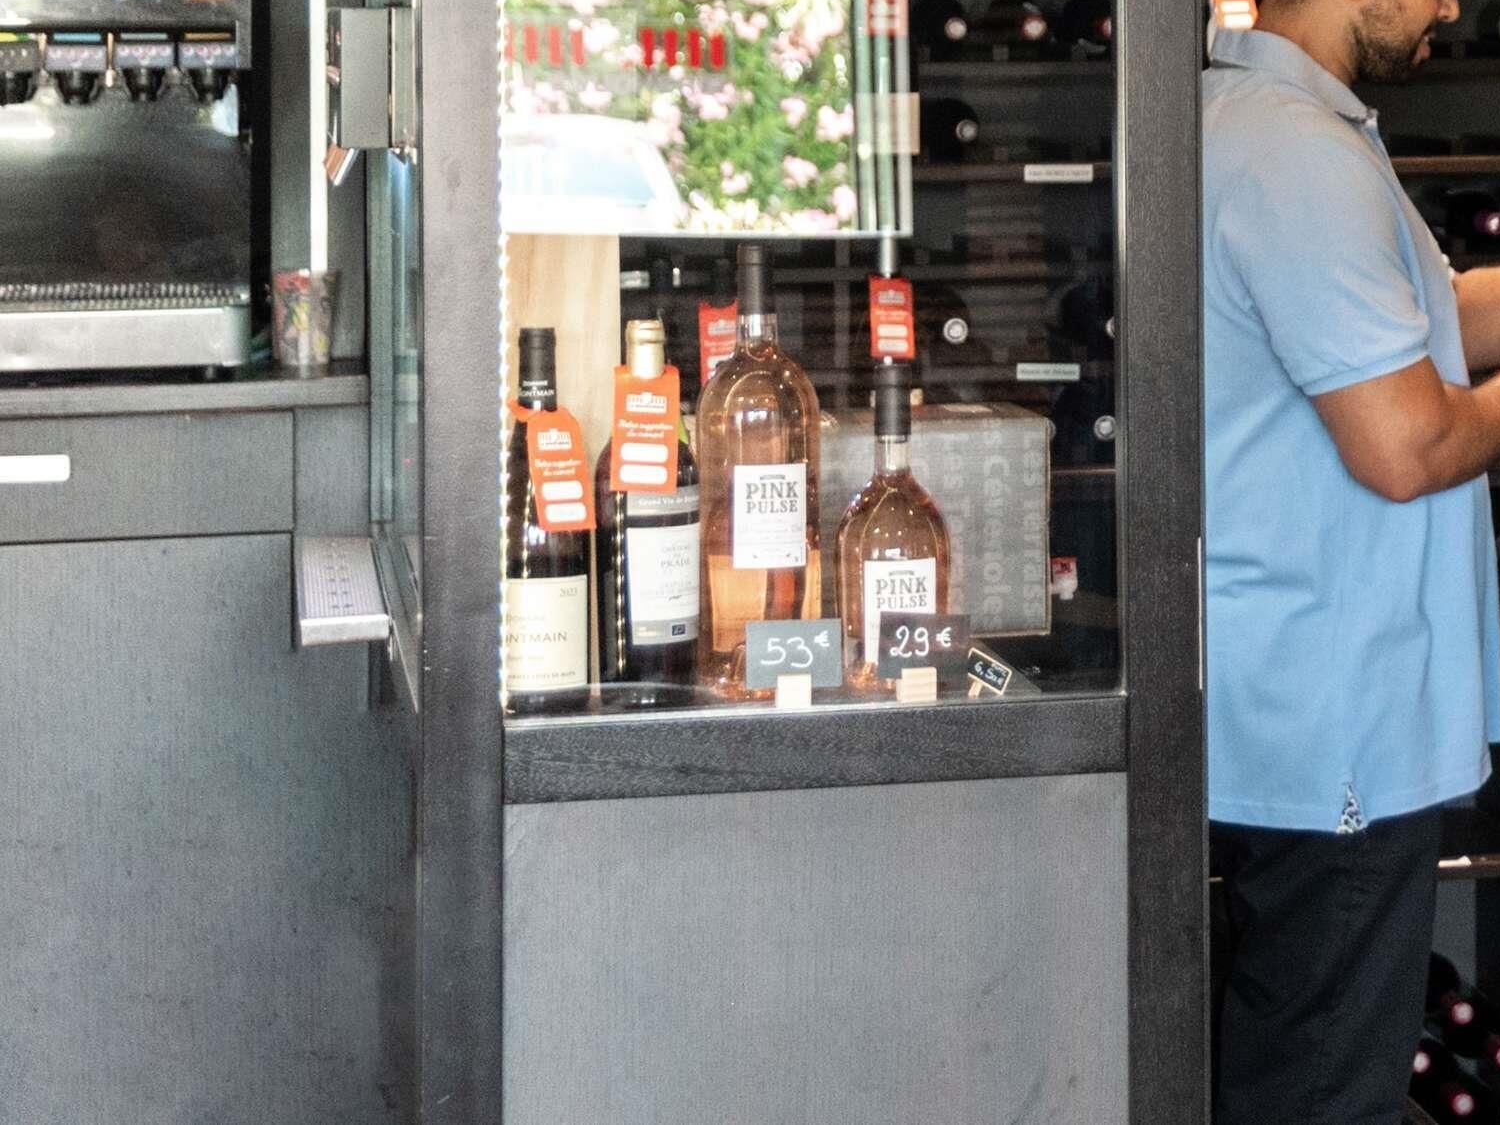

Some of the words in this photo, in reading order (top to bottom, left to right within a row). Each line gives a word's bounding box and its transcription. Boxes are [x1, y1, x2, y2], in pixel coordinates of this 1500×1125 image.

[745, 480, 799, 500] PINK
[746, 499, 798, 514] PULSE
[875, 576, 928, 596] PINK
[876, 594, 928, 611] PULSE
